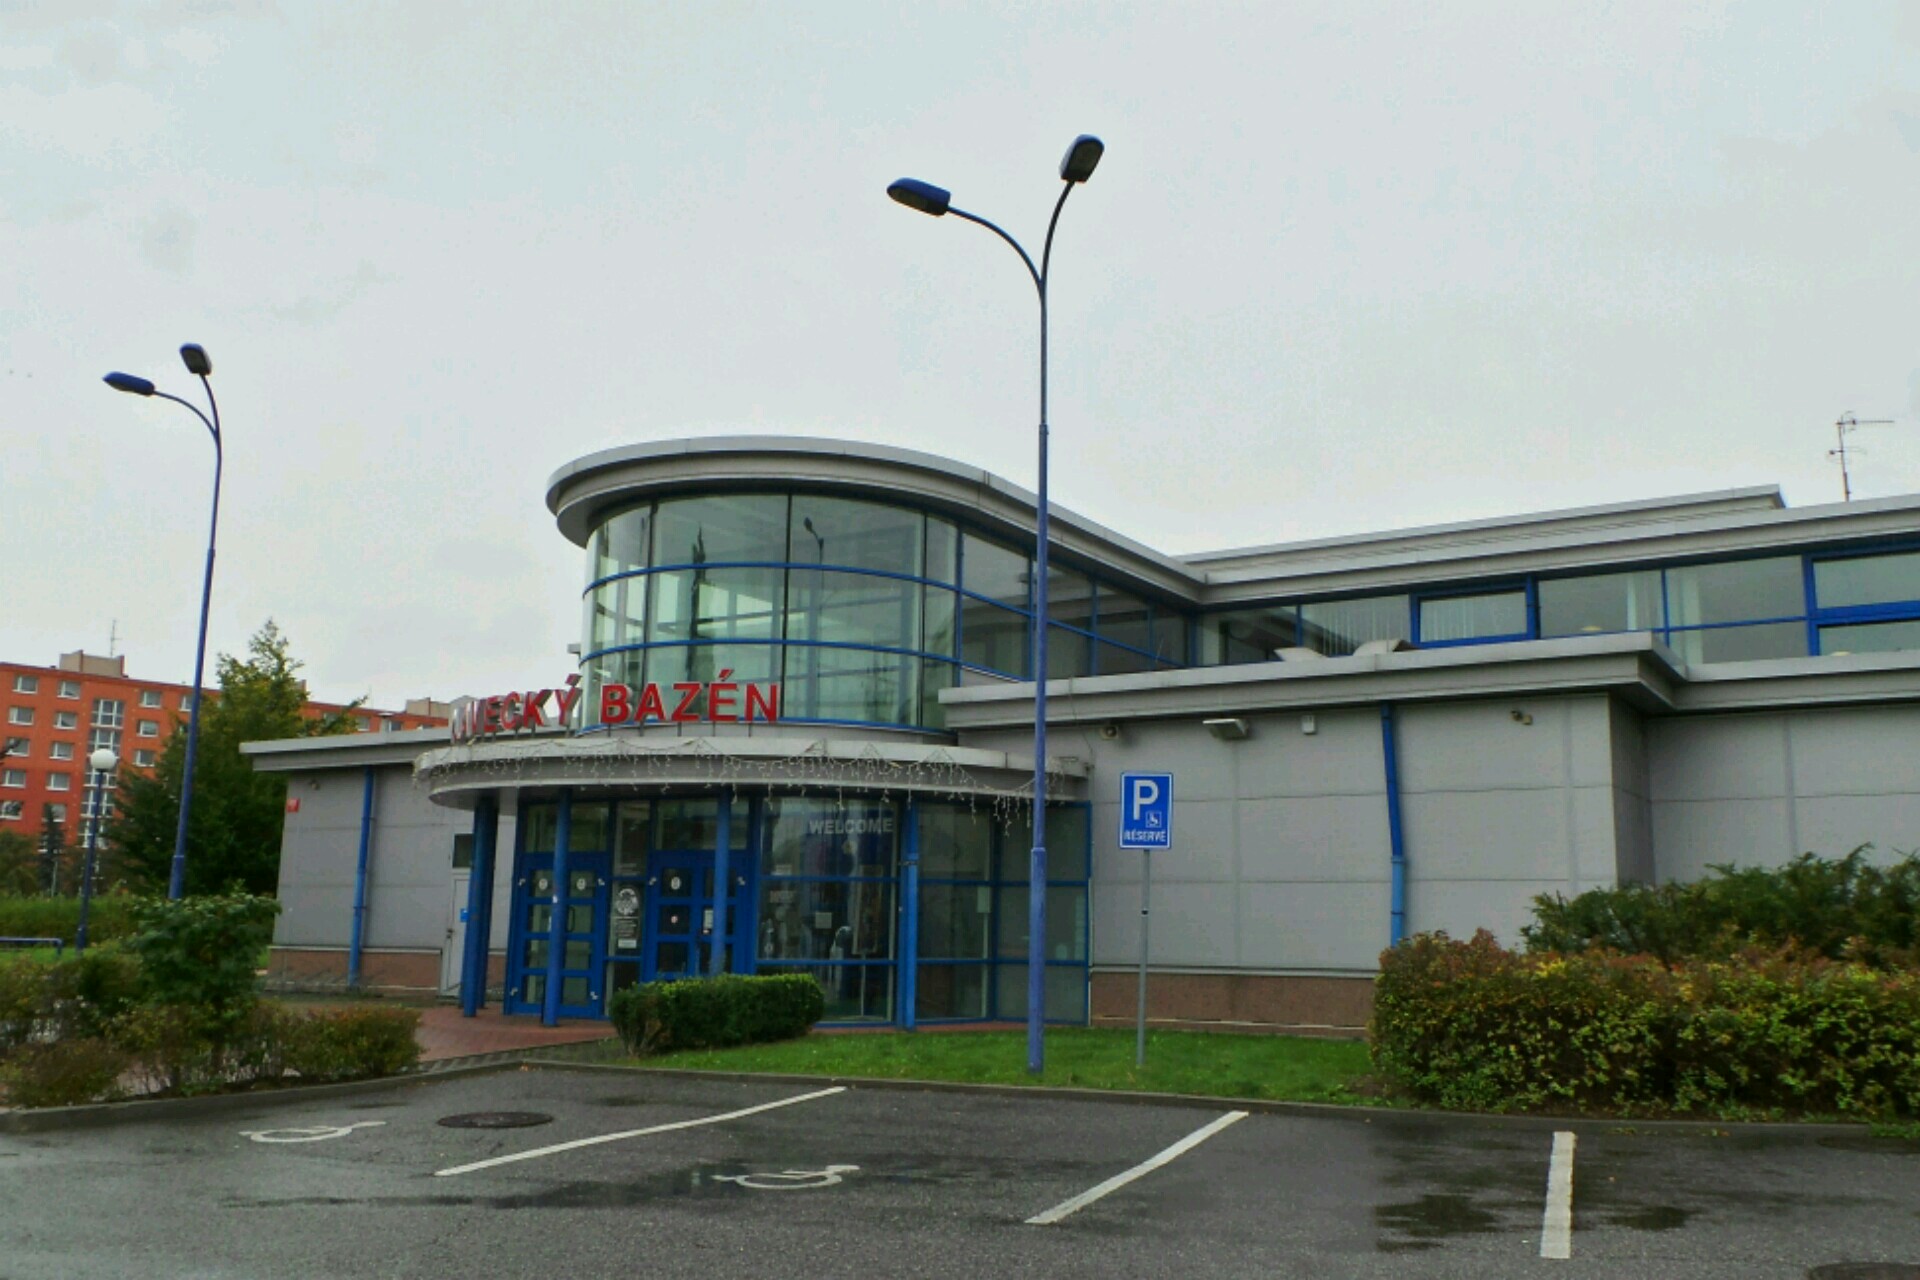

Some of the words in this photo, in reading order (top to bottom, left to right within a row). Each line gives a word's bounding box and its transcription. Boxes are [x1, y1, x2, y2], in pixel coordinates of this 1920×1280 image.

[601, 669, 779, 724] BAZÉN
[1133, 780, 1158, 820] P
[809, 818, 893, 834] WELCOME
